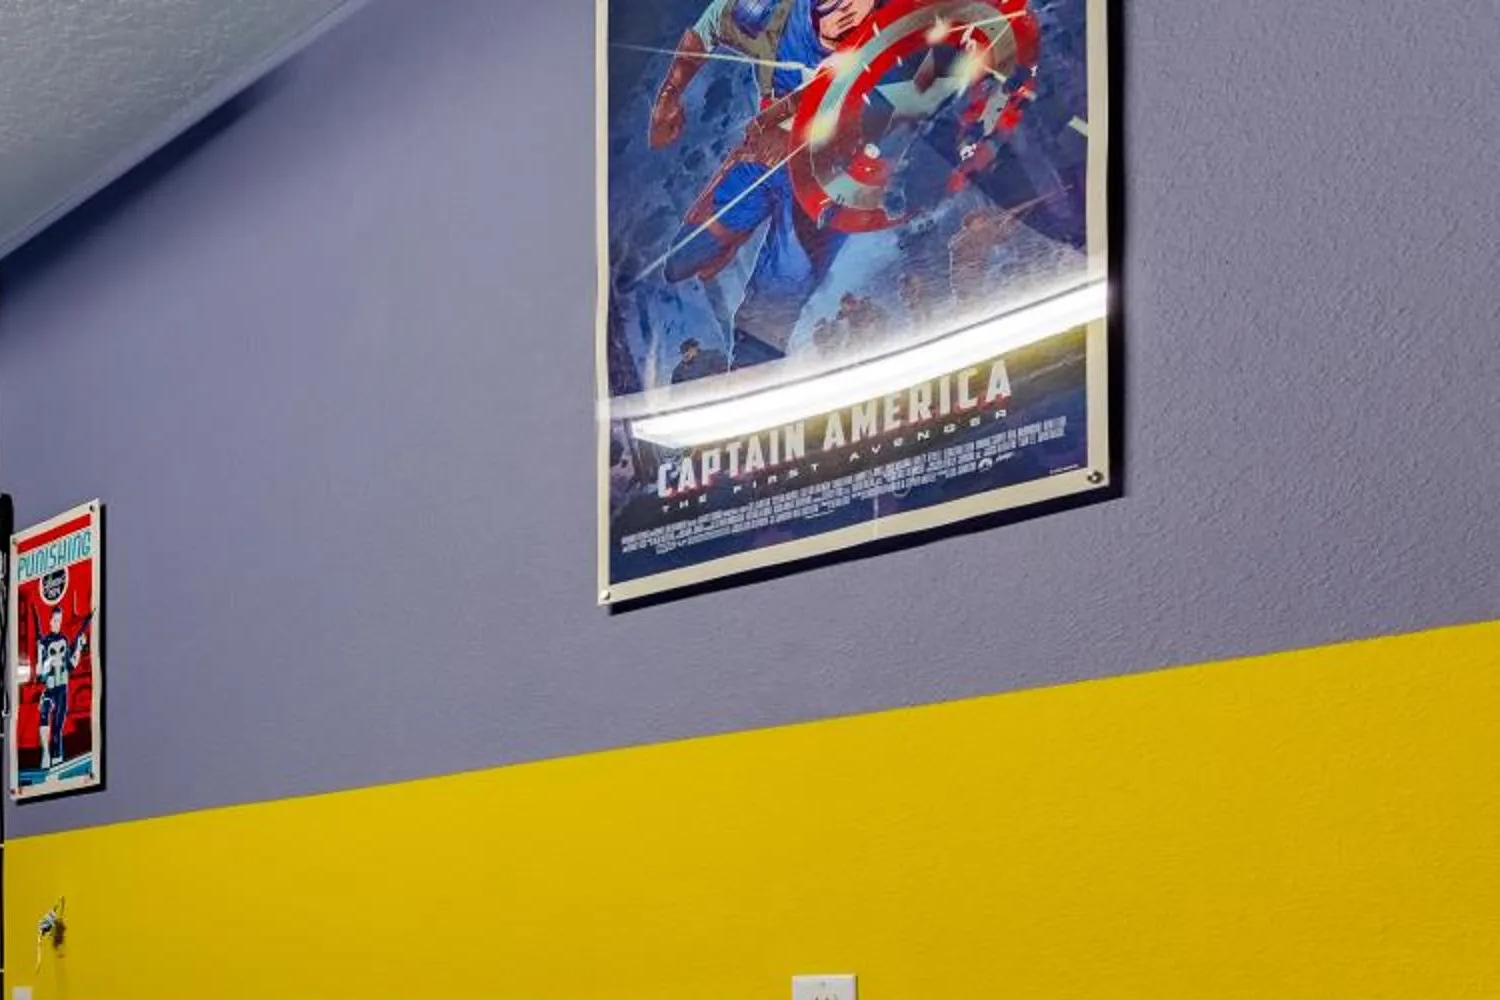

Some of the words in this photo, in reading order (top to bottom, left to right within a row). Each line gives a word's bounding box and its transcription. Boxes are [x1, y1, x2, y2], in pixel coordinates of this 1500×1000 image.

[656, 418, 806, 499] CAPTAIN
[821, 360, 1014, 453] AMERICA
[18, 529, 93, 581] PUNISHING
